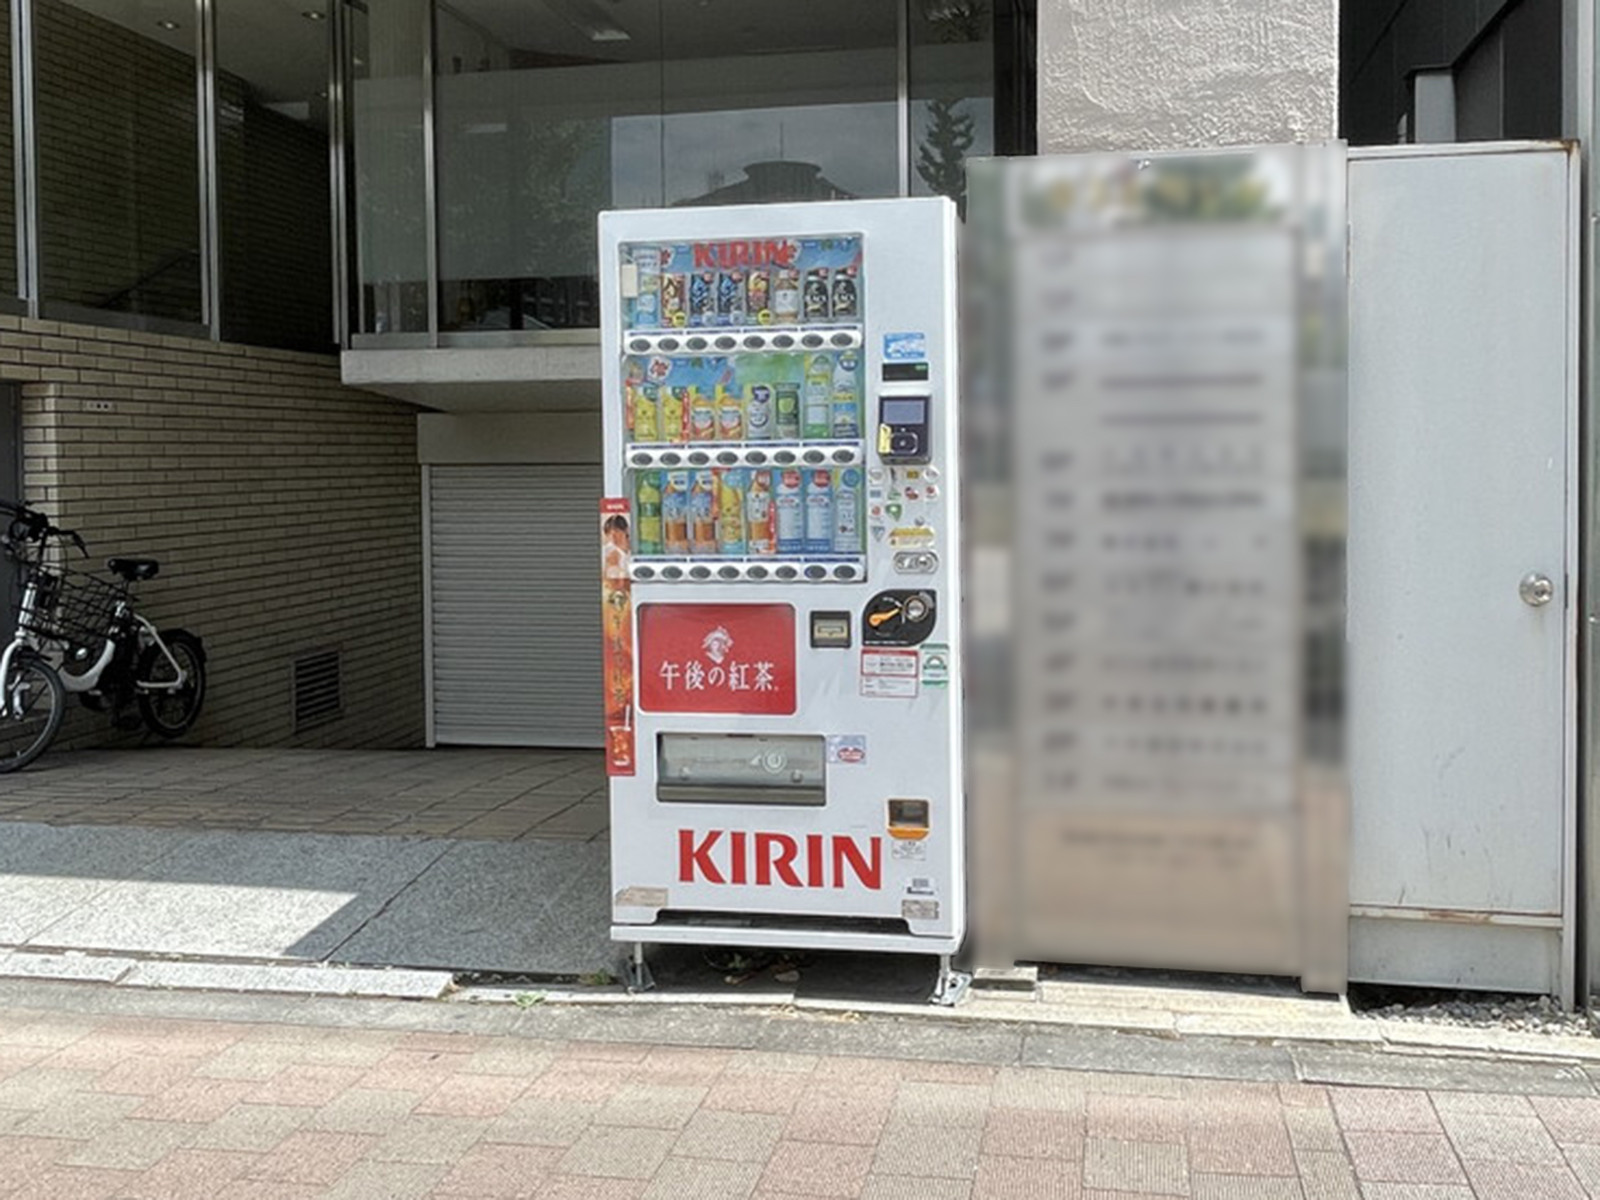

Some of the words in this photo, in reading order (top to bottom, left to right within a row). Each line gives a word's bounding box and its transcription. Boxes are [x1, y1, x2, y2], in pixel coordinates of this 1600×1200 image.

[694, 240, 788, 267] KIRIN
[660, 660, 775, 691] 午後の紅茶
[679, 829, 881, 890] KIRIN
